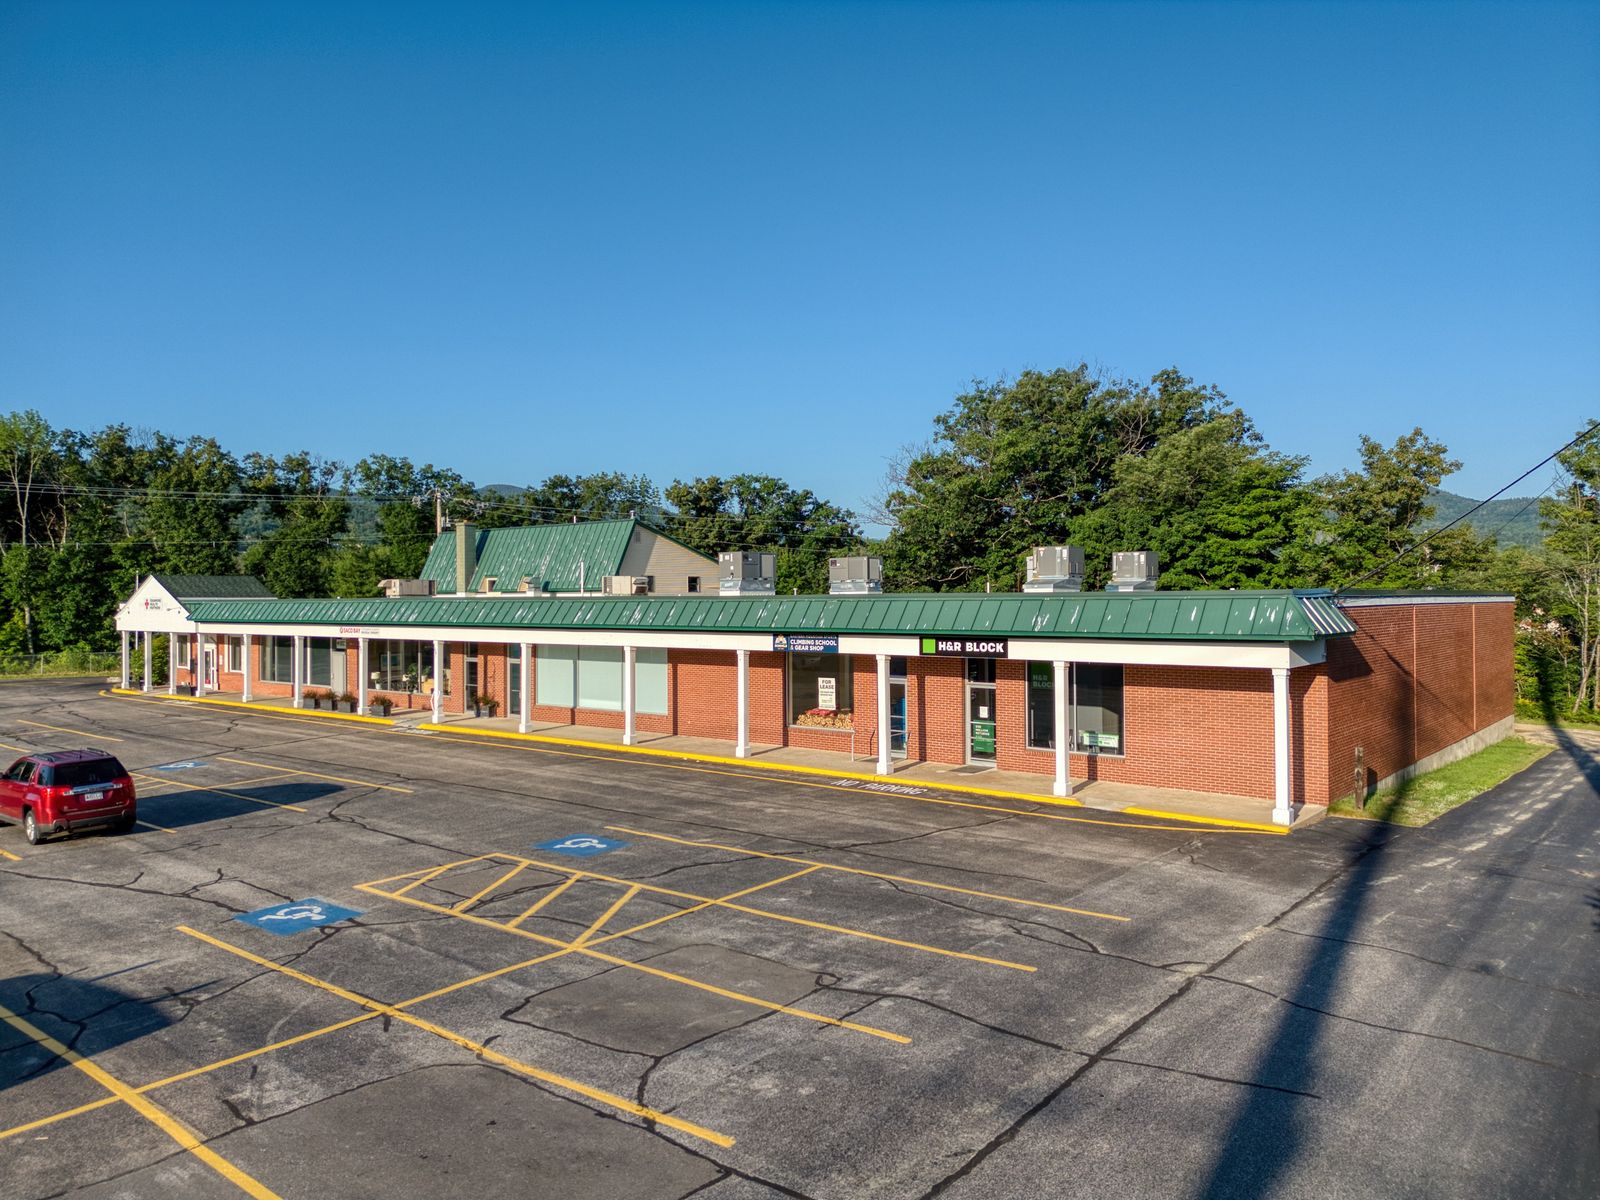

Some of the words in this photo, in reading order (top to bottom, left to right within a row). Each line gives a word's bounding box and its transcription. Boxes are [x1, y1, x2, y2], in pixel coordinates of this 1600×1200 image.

[938, 642, 962, 652] H&R
[966, 642, 1004, 653] BLOCK
[830, 778, 860, 786] NO
[858, 782, 928, 794] PARKING
